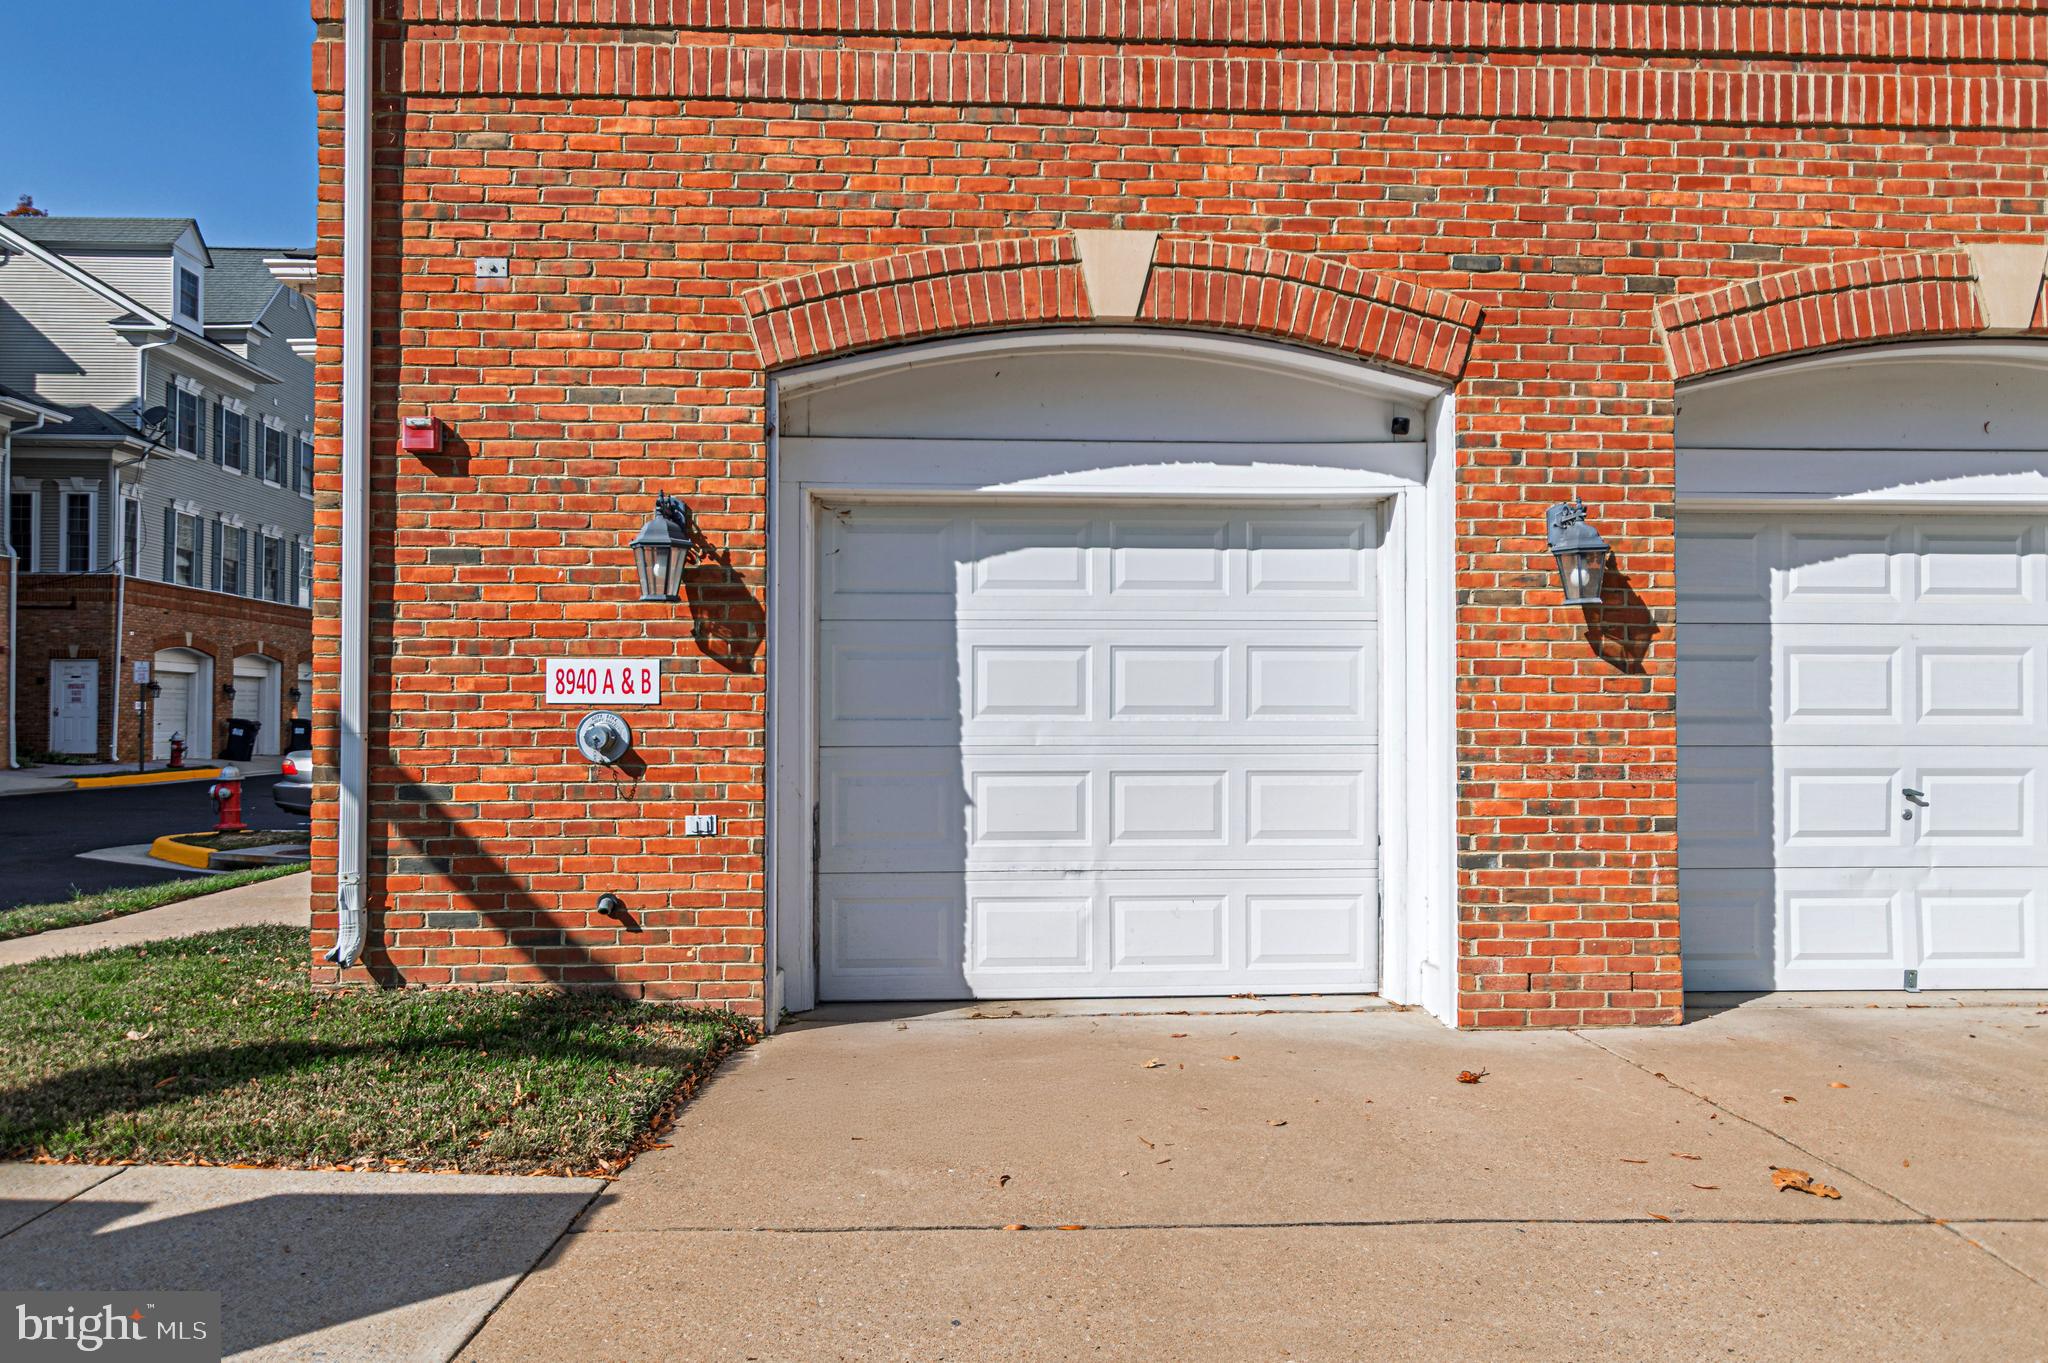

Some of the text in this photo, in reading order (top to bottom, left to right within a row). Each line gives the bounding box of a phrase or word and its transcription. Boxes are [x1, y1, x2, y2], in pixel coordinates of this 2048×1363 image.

[556, 667, 651, 694] 8940 A & B
